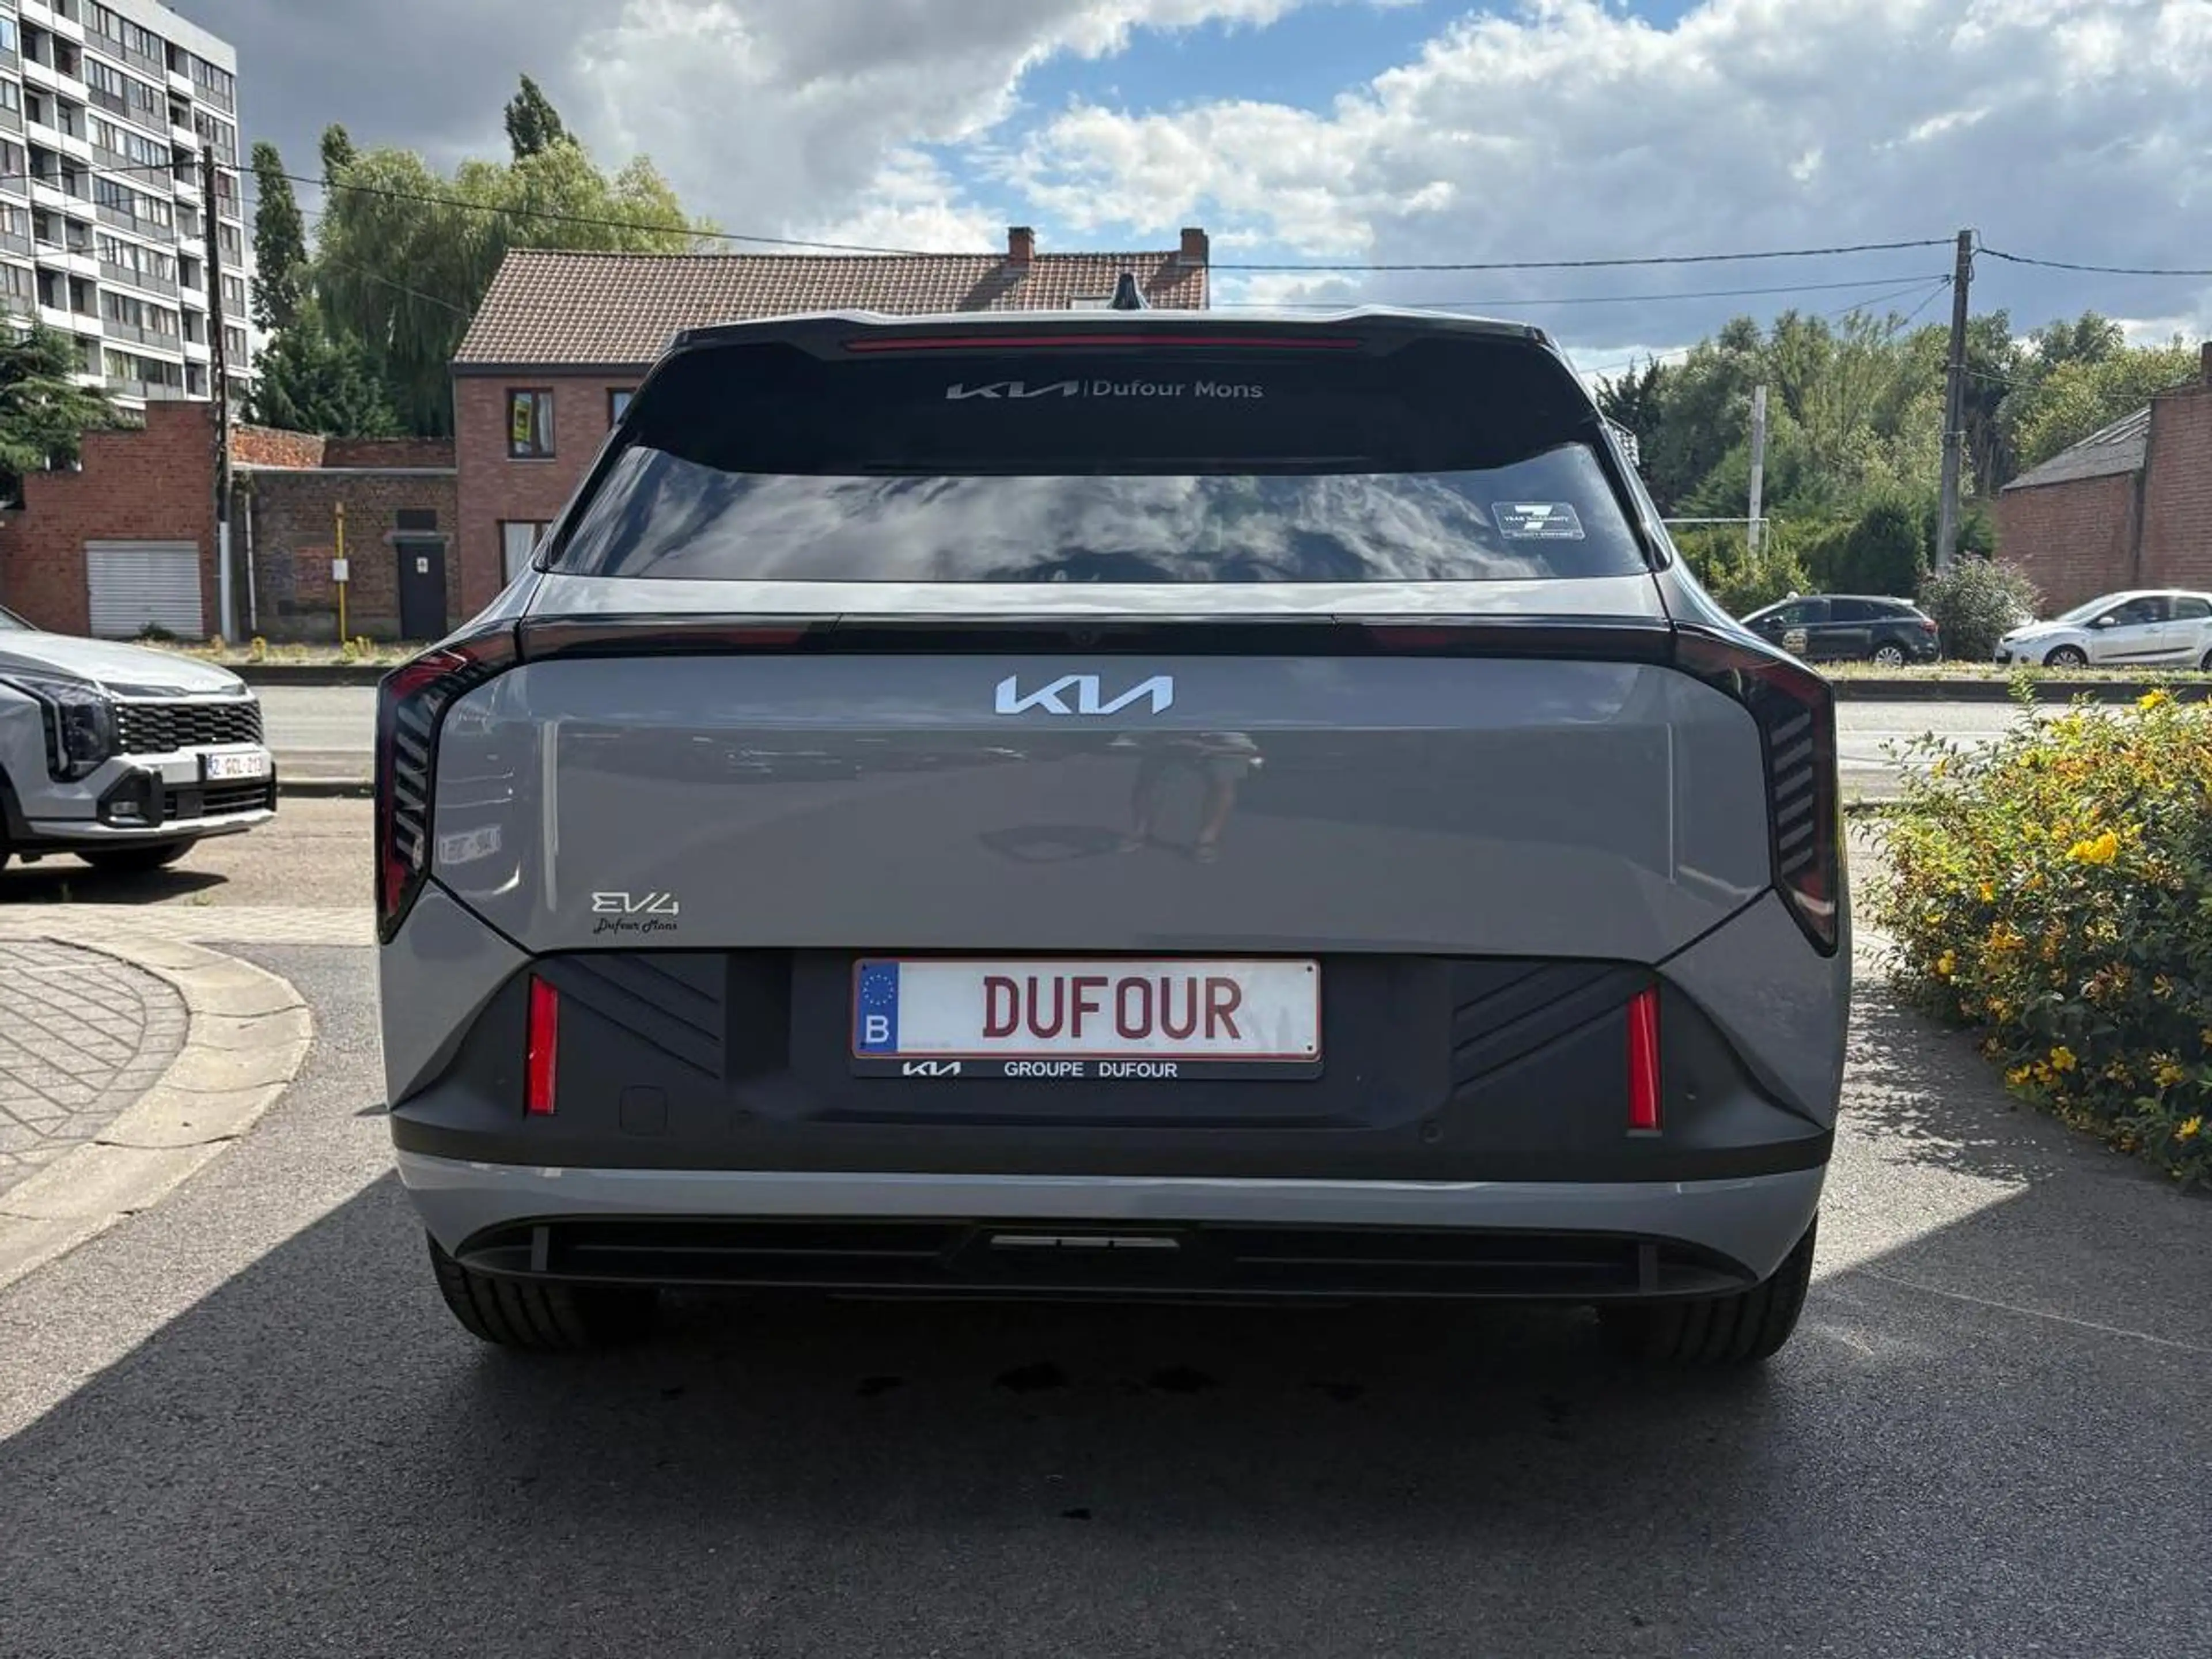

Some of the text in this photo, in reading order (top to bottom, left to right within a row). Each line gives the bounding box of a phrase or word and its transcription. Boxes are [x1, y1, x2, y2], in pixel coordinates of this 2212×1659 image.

[945, 380, 1264, 399] KIA Dufour Mons
[995, 674, 1174, 715] KIA
[592, 892, 679, 915] EV4
[593, 918, 677, 934] Dufour Mons
[983, 976, 1242, 1040] DUFOUR
[866, 1014, 889, 1043] B
[903, 1061, 1178, 1078] KIA GROUPE DUFOUR
